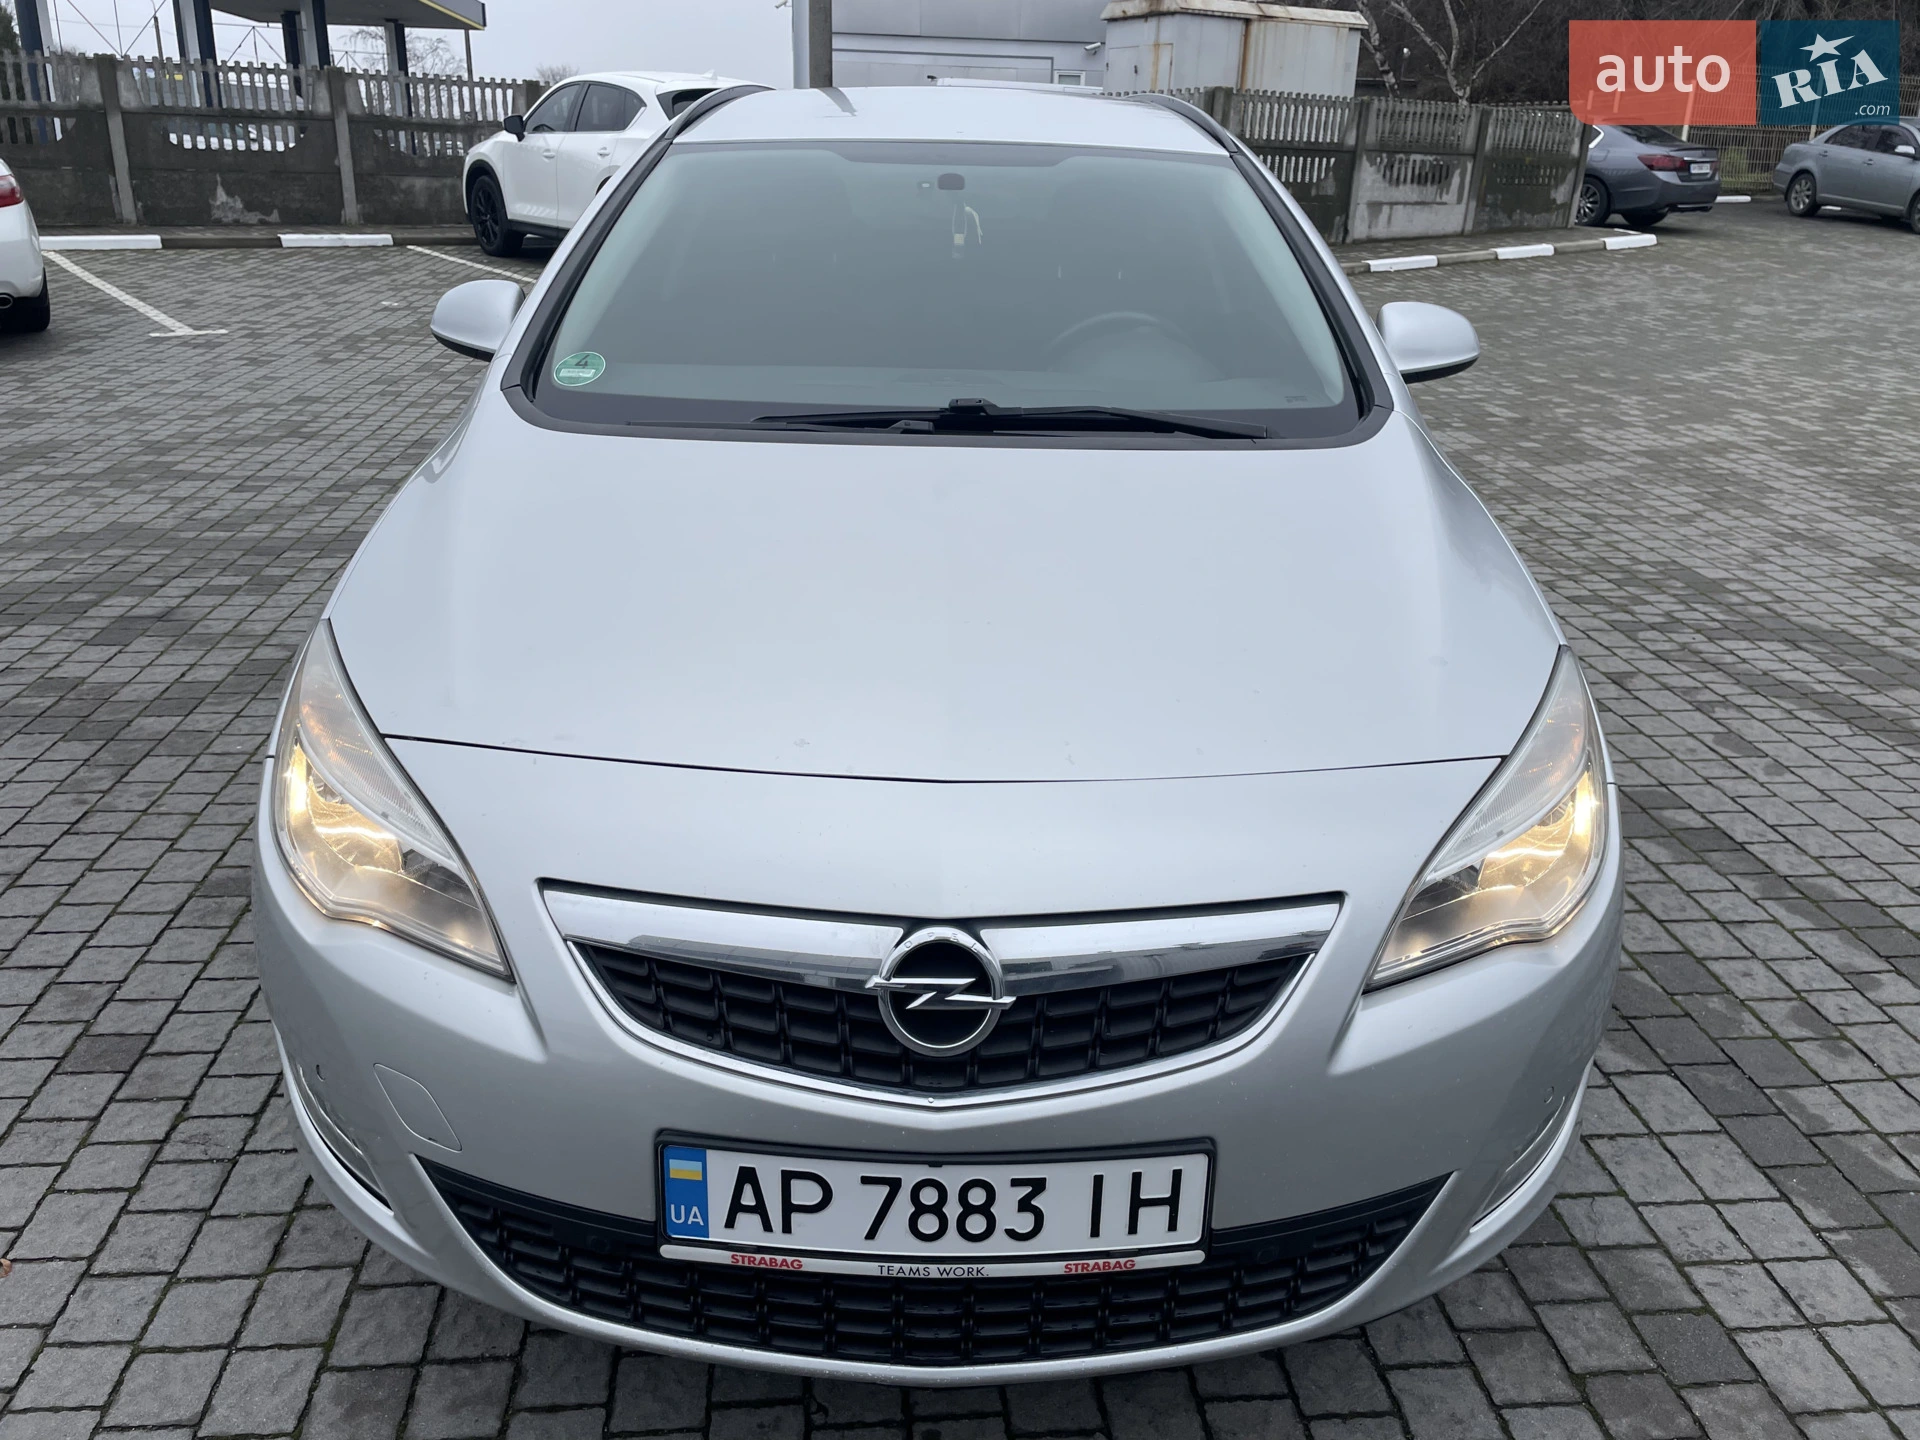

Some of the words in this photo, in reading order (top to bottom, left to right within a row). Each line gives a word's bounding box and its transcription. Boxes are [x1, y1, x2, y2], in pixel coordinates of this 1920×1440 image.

[575, 354, 590, 369] 4
[724, 1166, 833, 1234] AP
[860, 1175, 1047, 1242] 7883
[1090, 1169, 1182, 1237] IH
[670, 1204, 704, 1225] UA
[731, 1253, 803, 1270] STRABAG
[1064, 1259, 1136, 1274] STRABAG
[878, 1265, 930, 1277] TEAMS
[937, 1266, 989, 1277] WORK.
